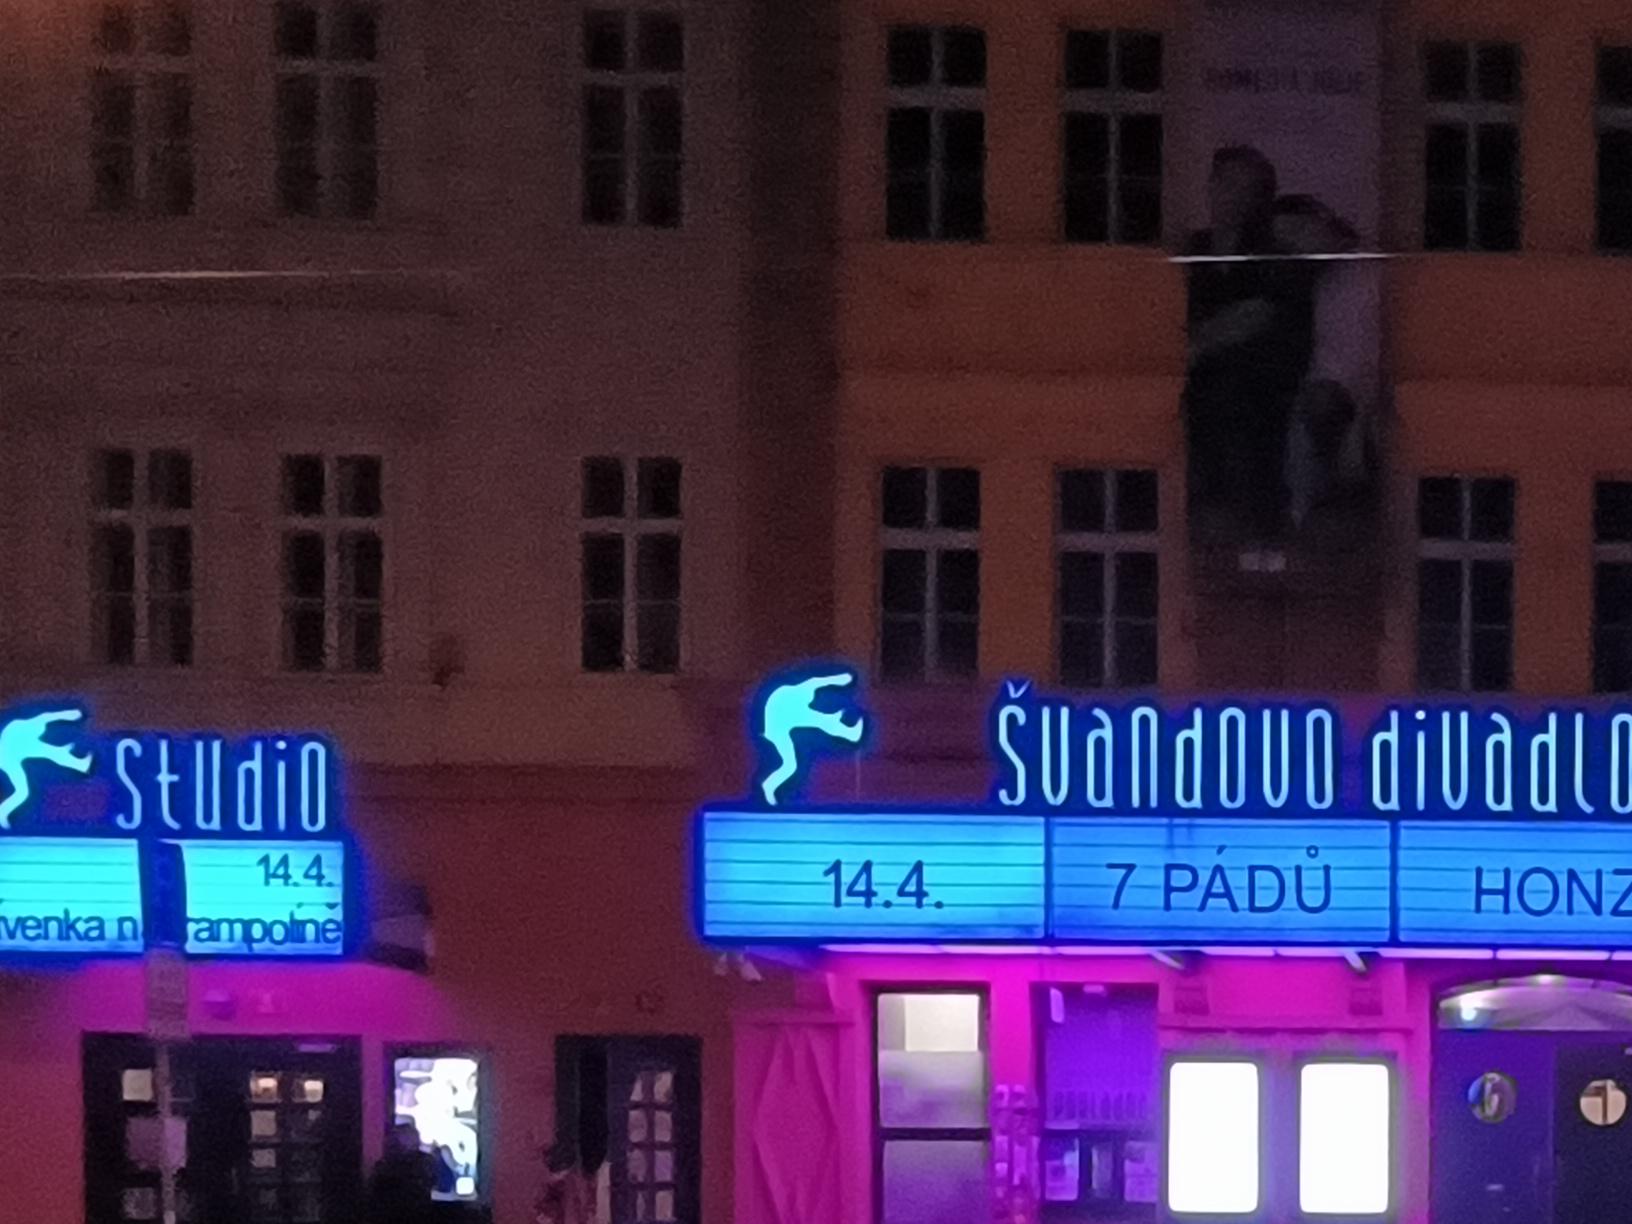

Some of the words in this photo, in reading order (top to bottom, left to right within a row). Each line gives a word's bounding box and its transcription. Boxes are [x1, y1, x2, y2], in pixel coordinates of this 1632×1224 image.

[998, 680, 1334, 810] Švandovo
[116, 738, 327, 832] Studio
[256, 853, 335, 888] 14.4.
[823, 859, 945, 910] 14.4.
[1105, 863, 1138, 911] 7
[1162, 845, 1333, 914] PÁDŮ
[0, 907, 106, 942] venka
[116, 915, 140, 942] n
